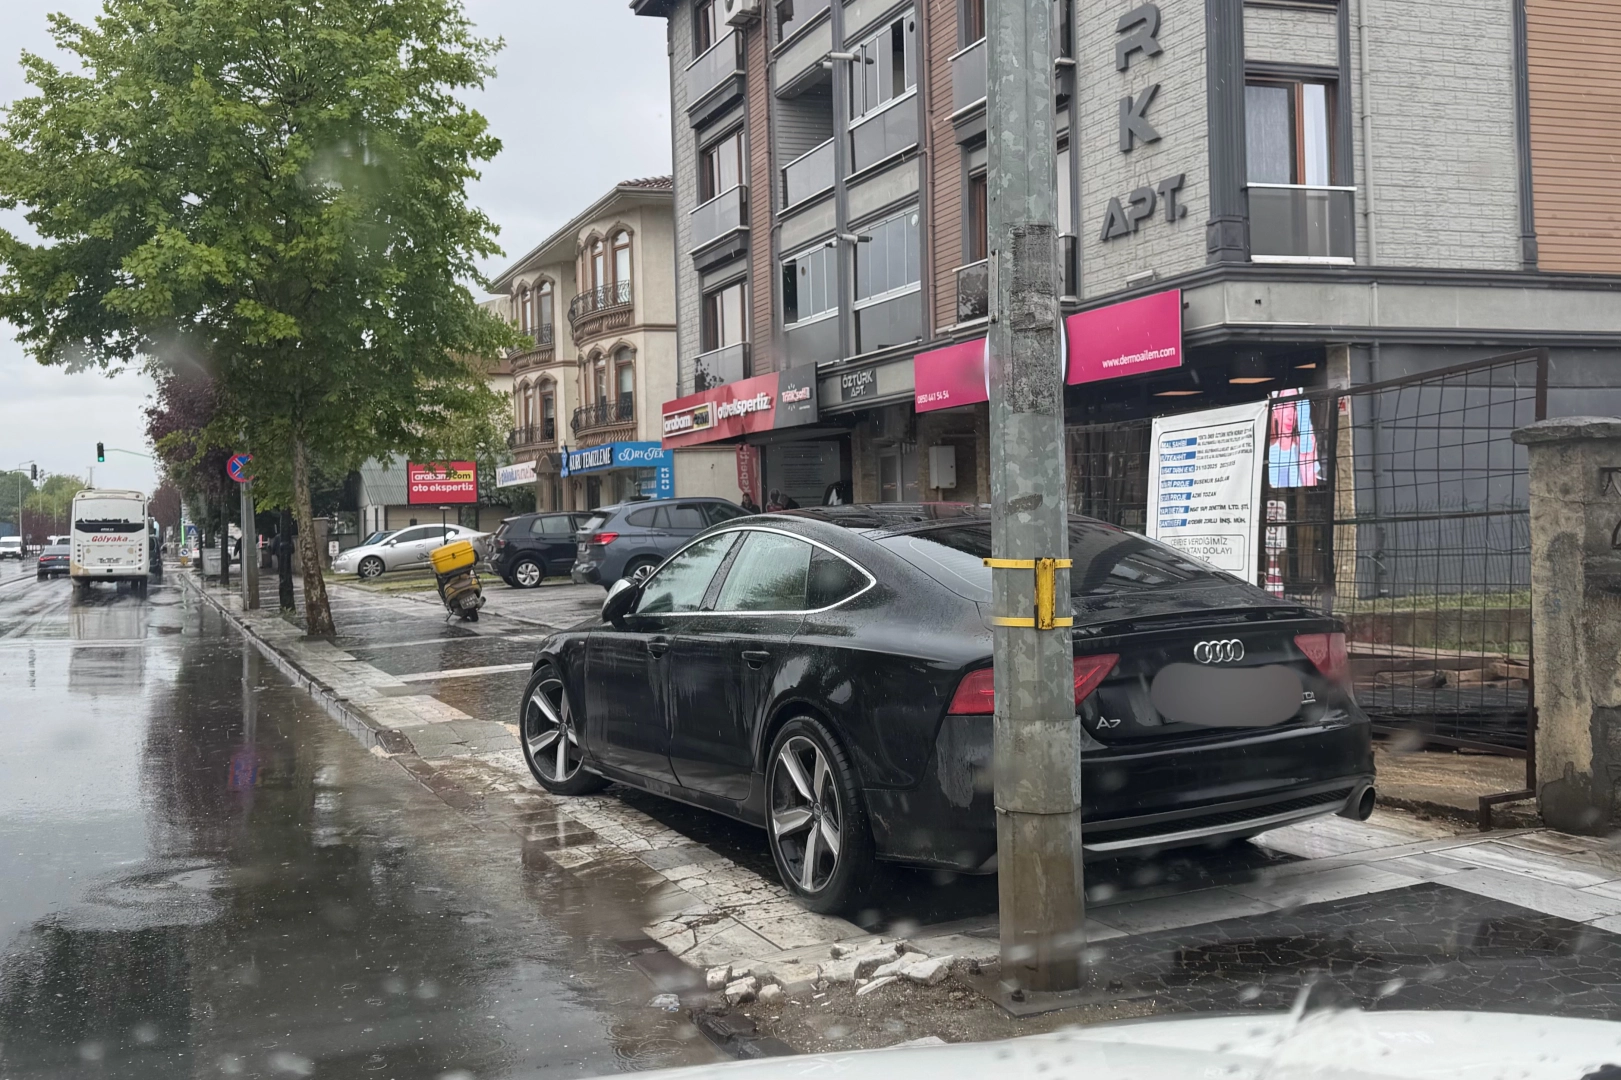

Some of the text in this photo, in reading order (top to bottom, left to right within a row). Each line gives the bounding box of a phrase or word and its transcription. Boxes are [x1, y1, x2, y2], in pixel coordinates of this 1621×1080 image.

[1100, 173, 1188, 241] APT.
[1102, 347, 1176, 368] www.dermoailem.com
[842, 370, 873, 388] ÖZTÜRK
[850, 385, 867, 398] APT.
[412, 482, 474, 493] oto ekspertiz
[91, 535, 129, 543] Gölyaka
[1202, 546, 1233, 555] DOLAYI
[1095, 716, 1122, 730] A7
